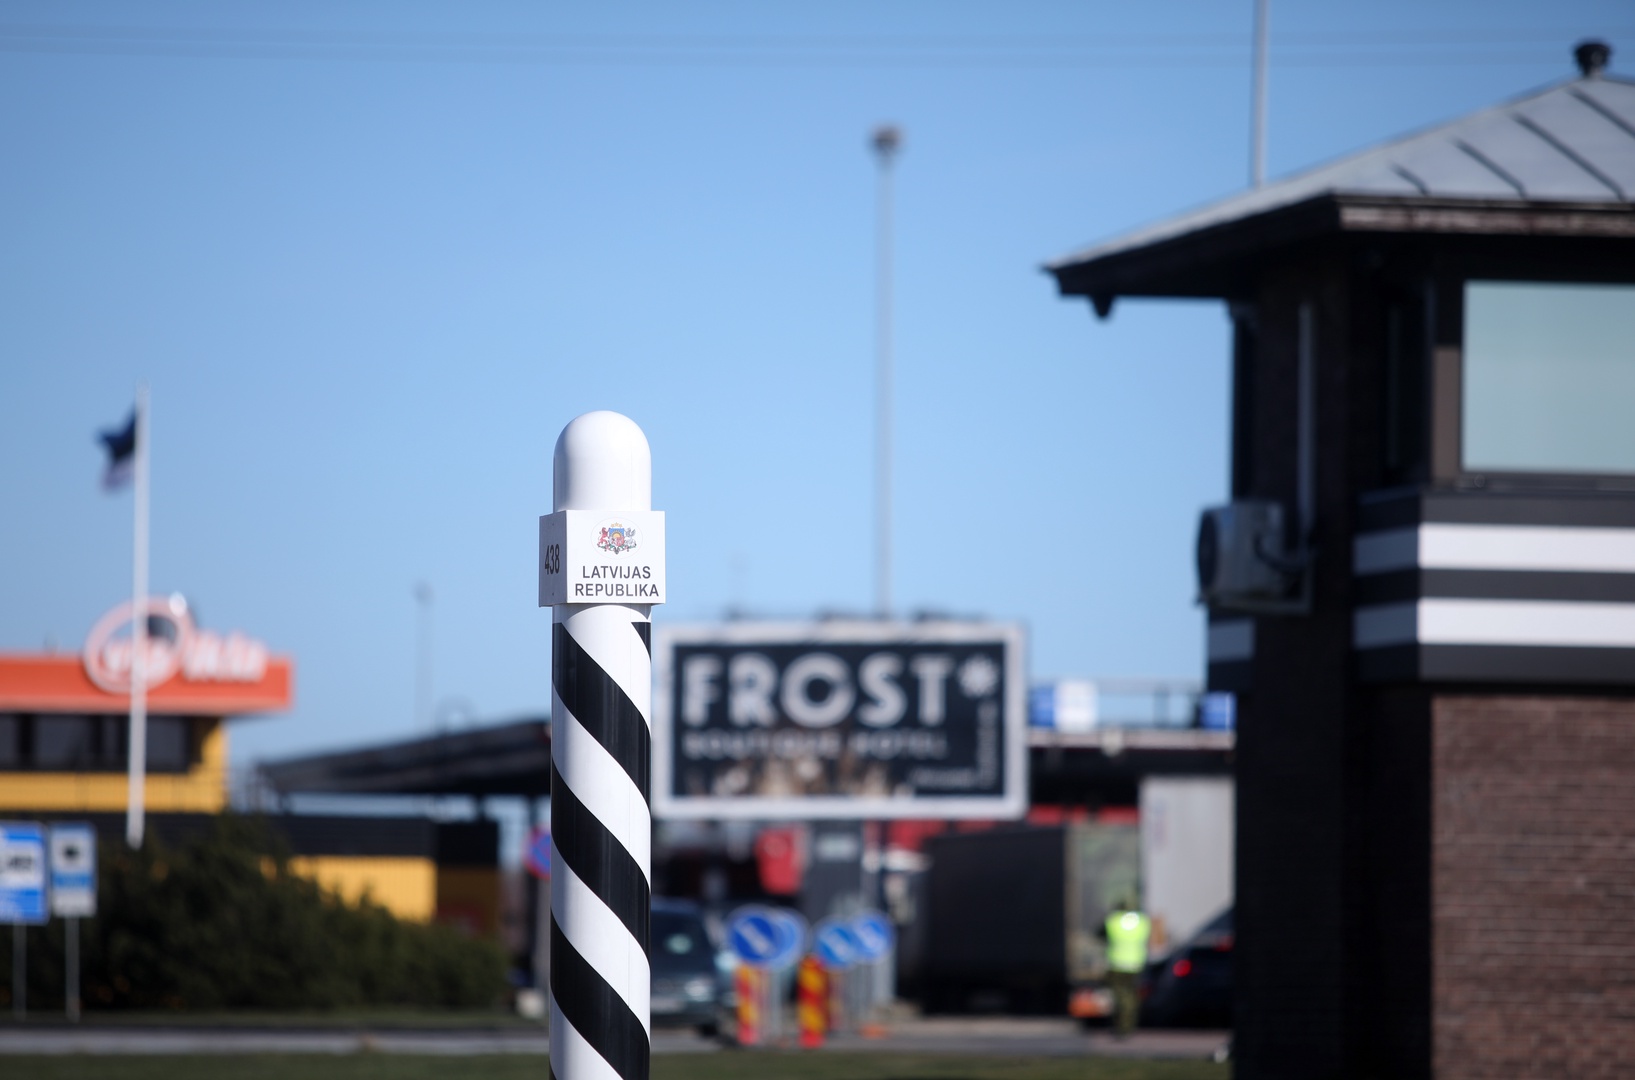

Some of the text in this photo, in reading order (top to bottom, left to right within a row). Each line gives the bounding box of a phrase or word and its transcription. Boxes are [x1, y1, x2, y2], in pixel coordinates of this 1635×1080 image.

[545, 544, 560, 575] 438
[582, 565, 651, 579] LATVIJAS
[575, 583, 659, 597] REPUBLIKA
[682, 653, 952, 727] FROST
